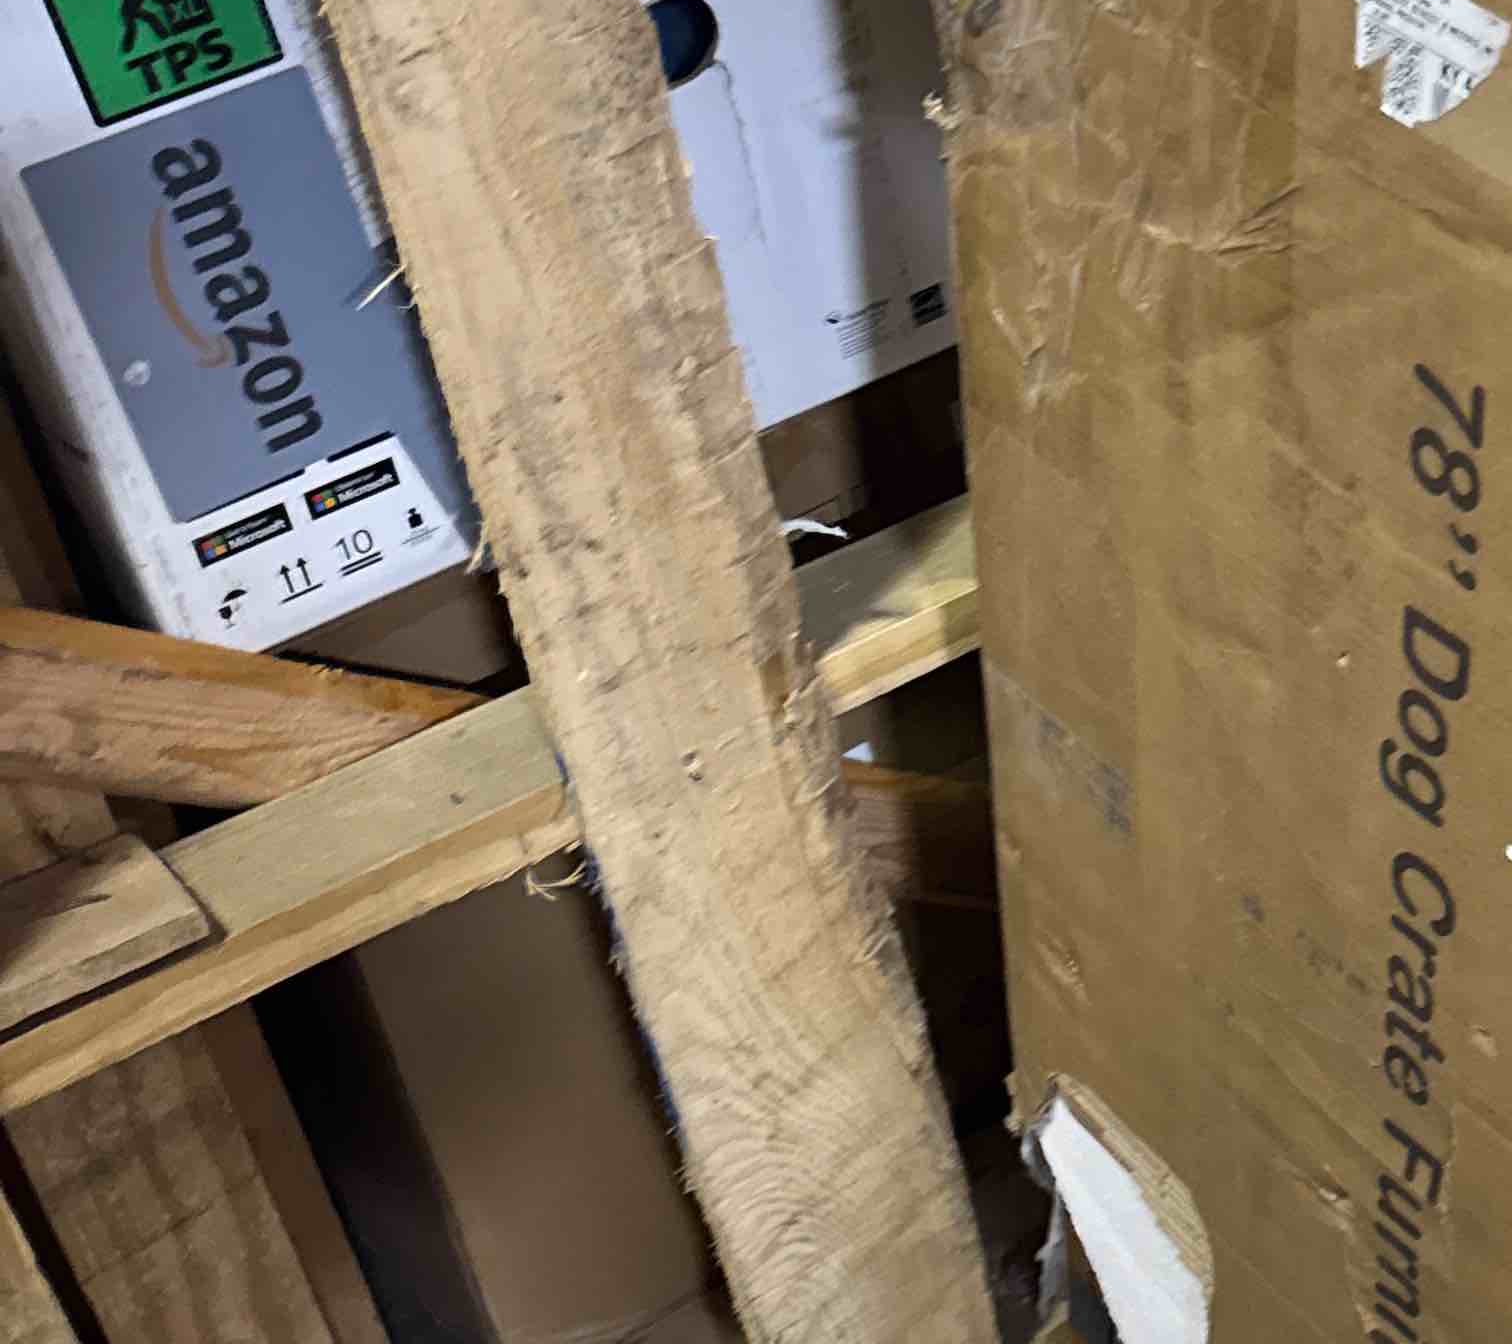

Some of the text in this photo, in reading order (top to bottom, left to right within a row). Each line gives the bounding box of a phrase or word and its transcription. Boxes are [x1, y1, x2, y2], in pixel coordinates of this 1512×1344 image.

[126, 27, 233, 93] TPS
[151, 137, 323, 455] amazon
[335, 529, 374, 561] 10
[1379, 603, 1471, 828] Dog
[1382, 852, 1456, 1106] Crate
